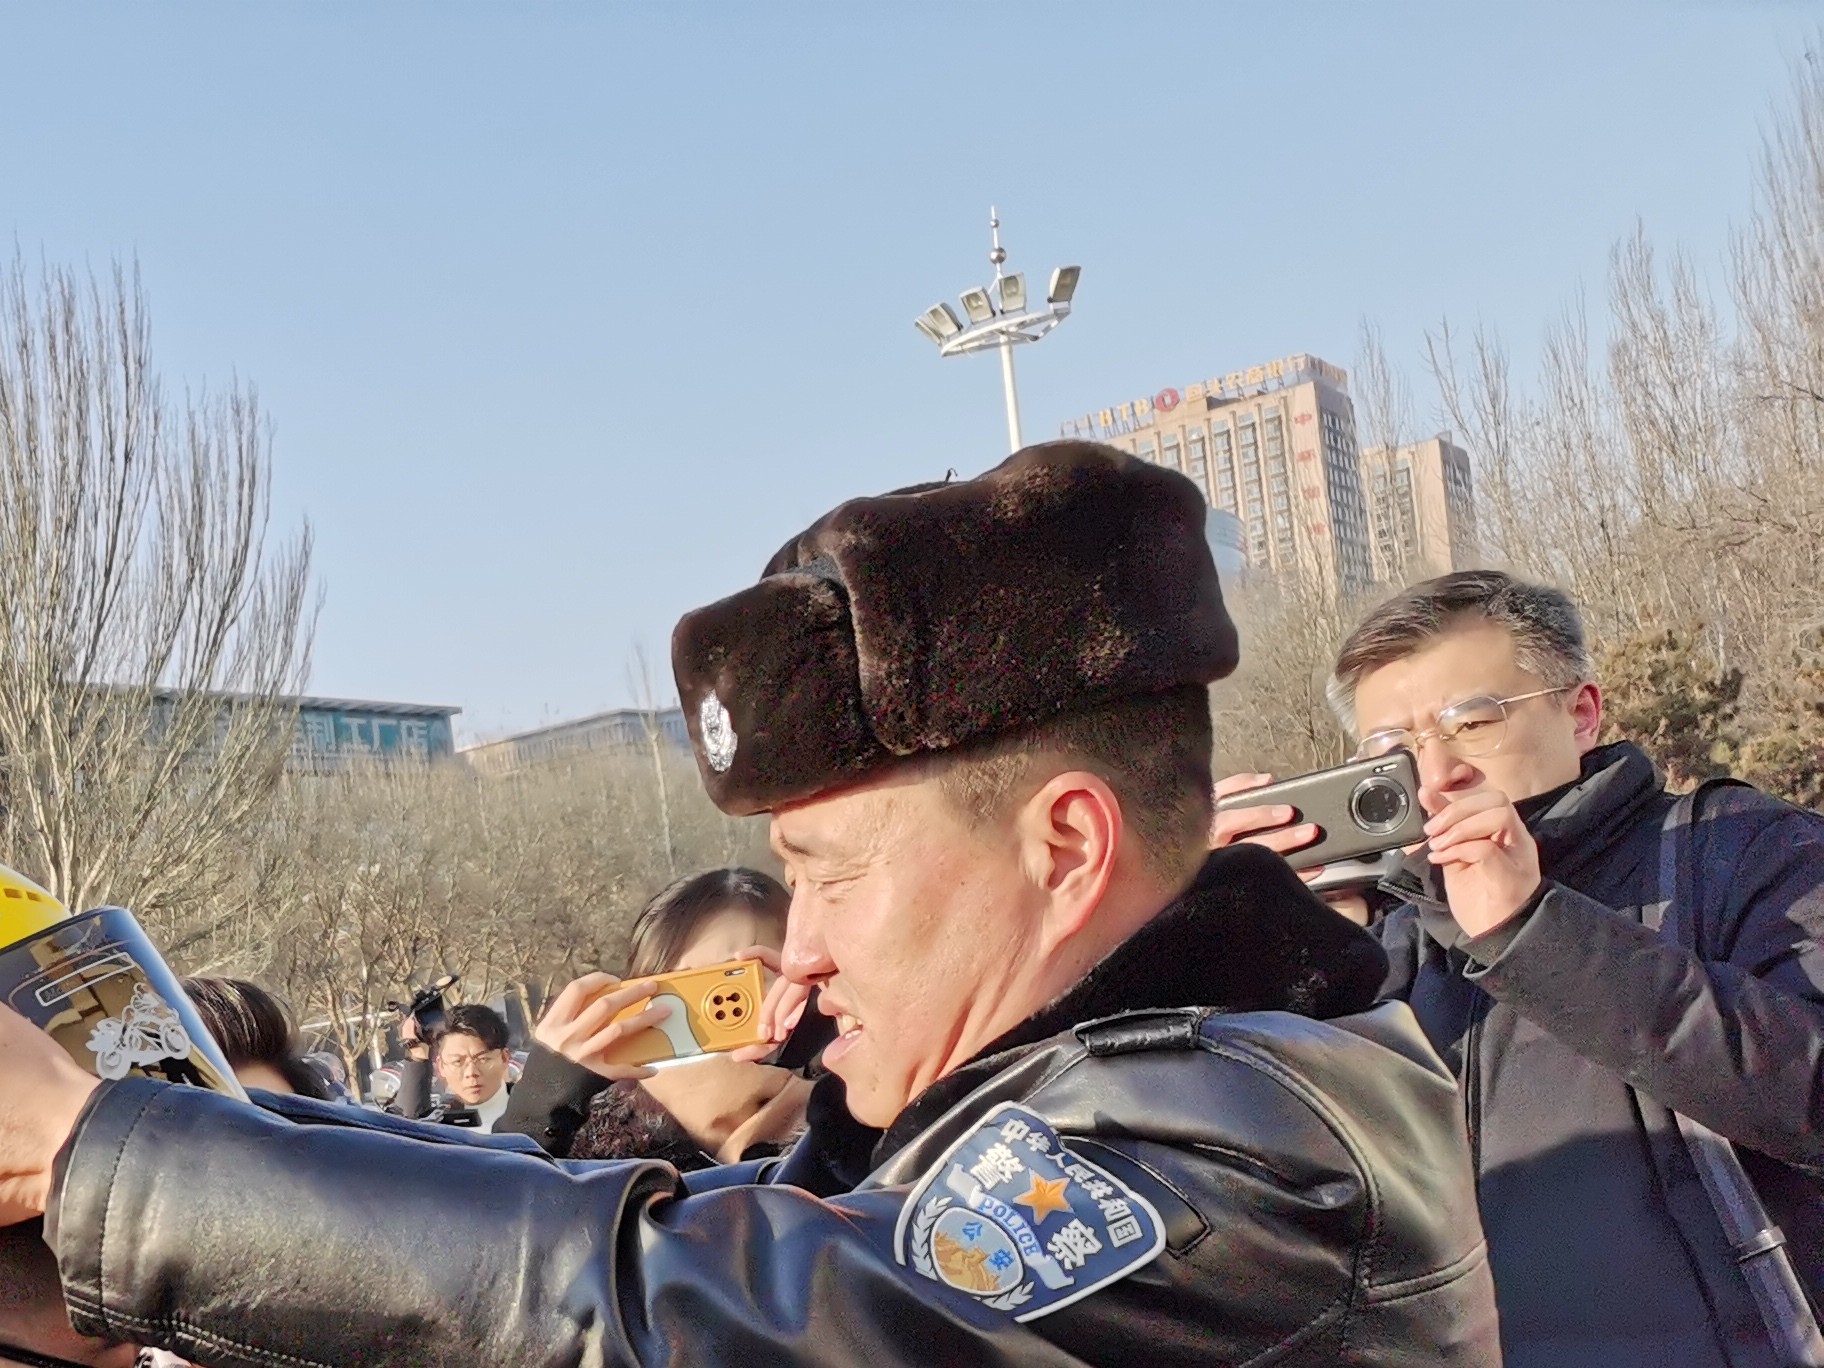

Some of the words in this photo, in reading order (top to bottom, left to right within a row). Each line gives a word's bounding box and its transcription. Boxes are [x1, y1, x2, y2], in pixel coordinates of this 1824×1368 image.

[970, 1142, 1103, 1270] 警察
[977, 1196, 1041, 1257] POLICE
[999, 1118, 1144, 1248] 中华人民共和国
[962, 1221, 1014, 1271] 公安
